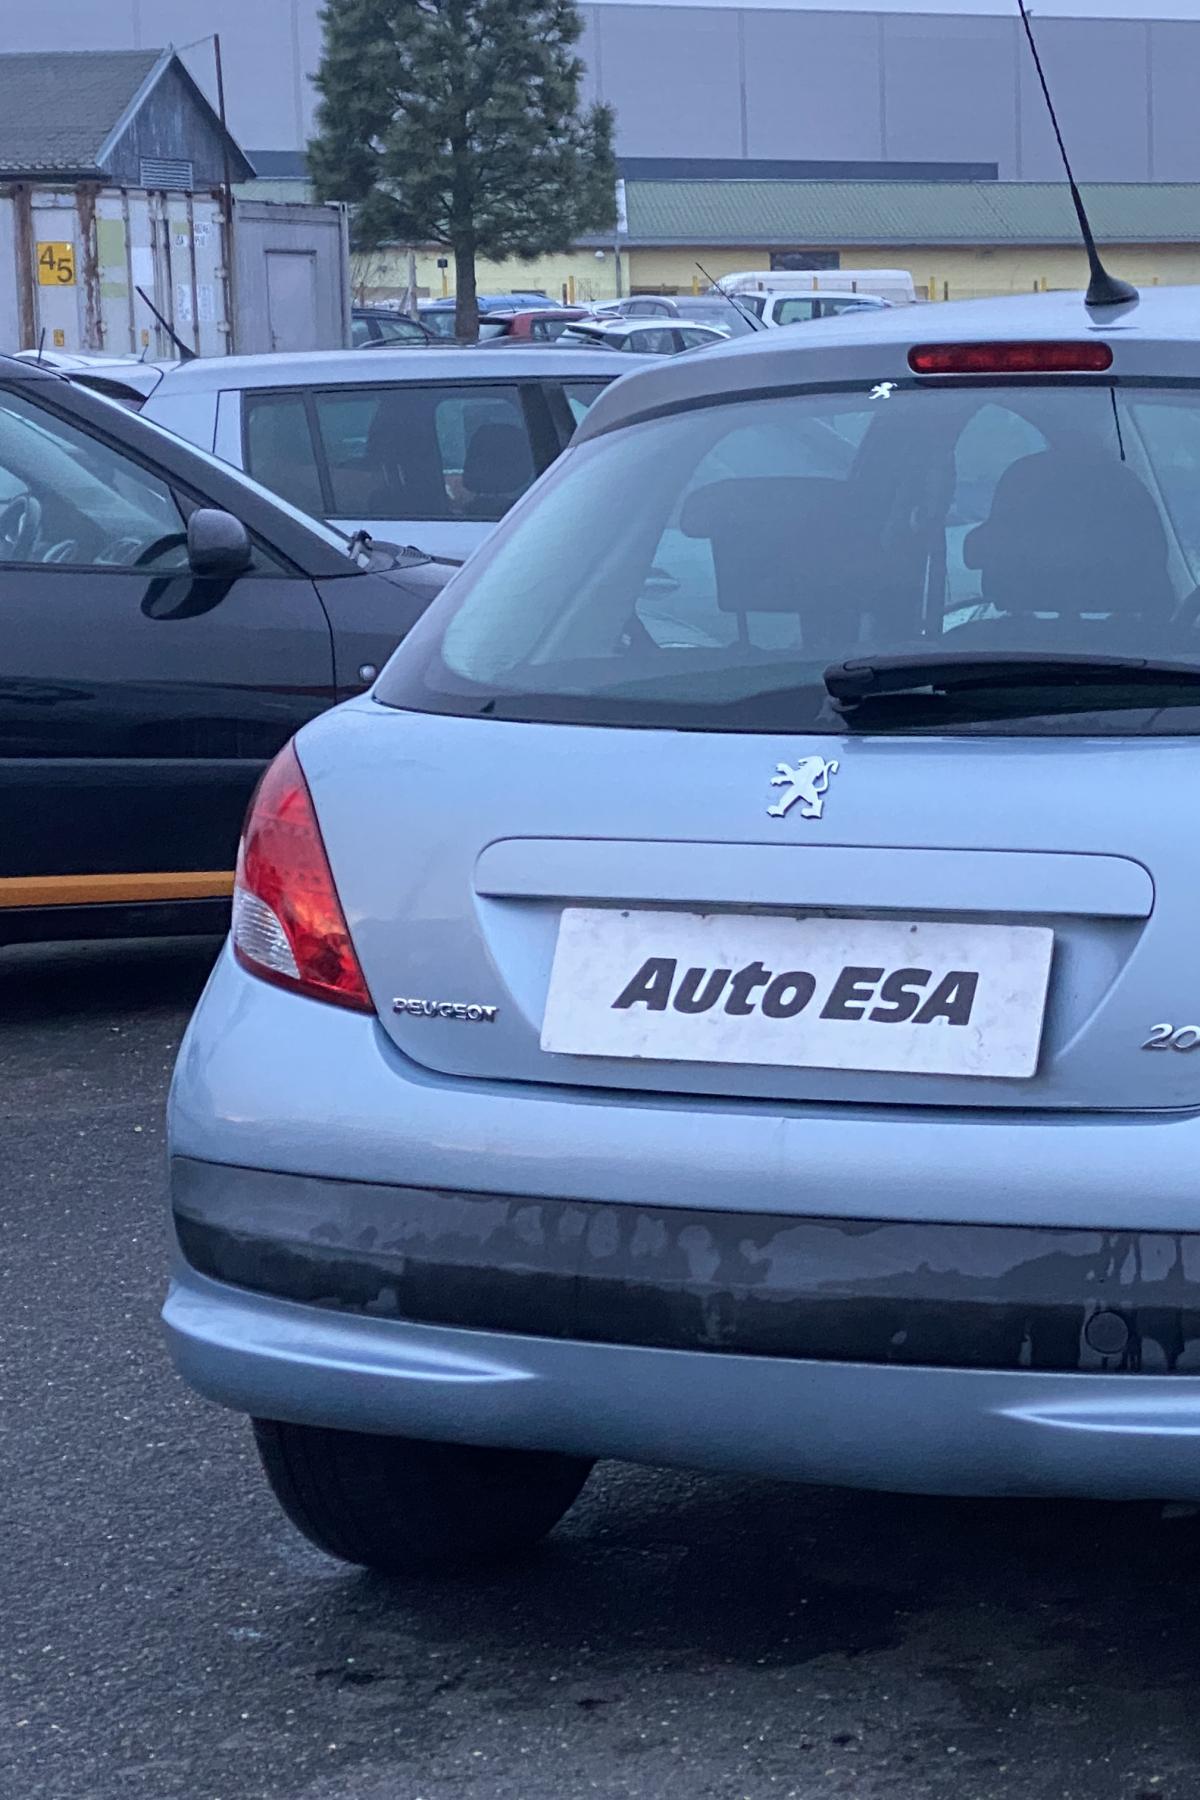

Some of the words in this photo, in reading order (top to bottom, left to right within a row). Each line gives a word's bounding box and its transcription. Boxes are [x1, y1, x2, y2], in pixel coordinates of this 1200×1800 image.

[392, 997, 498, 1022] PEUGEOT
[611, 957, 816, 1018] Auto
[818, 966, 979, 1026] ESA
